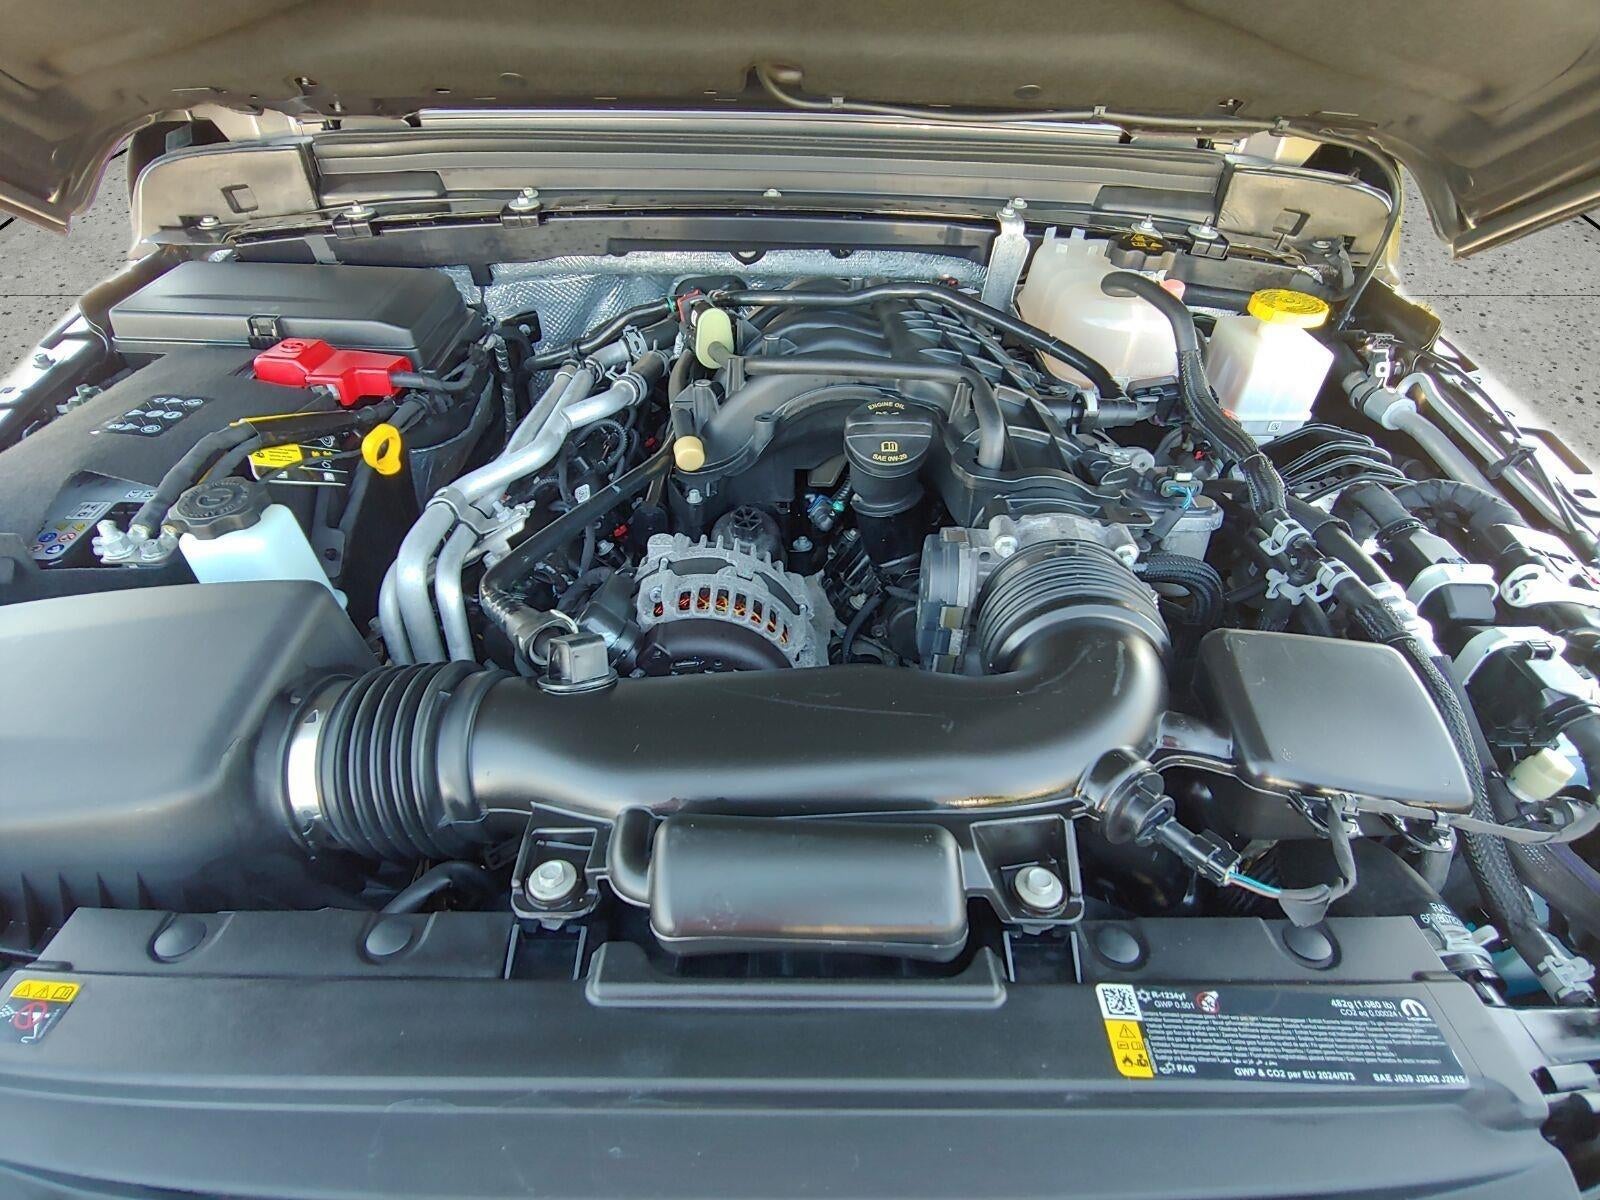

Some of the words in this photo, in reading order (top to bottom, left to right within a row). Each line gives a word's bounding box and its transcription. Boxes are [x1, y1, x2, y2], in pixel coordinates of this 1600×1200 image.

[867, 401, 893, 411] ENGINE
[894, 402, 905, 410] OIL
[872, 453, 887, 461] SAE
[887, 453, 908, 461] 0W-20
[1429, 902, 1451, 914] RAD
[1151, 991, 1186, 1001] R-1234yf
[1154, 1000, 1173, 1008] GWP
[1340, 1008, 1358, 1016] CO2
[1176, 1064, 1196, 1074] PAG
[1234, 1067, 1256, 1077] GWP
[1258, 1068, 1266, 1077] &
[1266, 1069, 1285, 1078] CO2
[1287, 1071, 1302, 1080] per
[1302, 1070, 1316, 1079] EU
[1373, 1073, 1393, 1082] SAE
